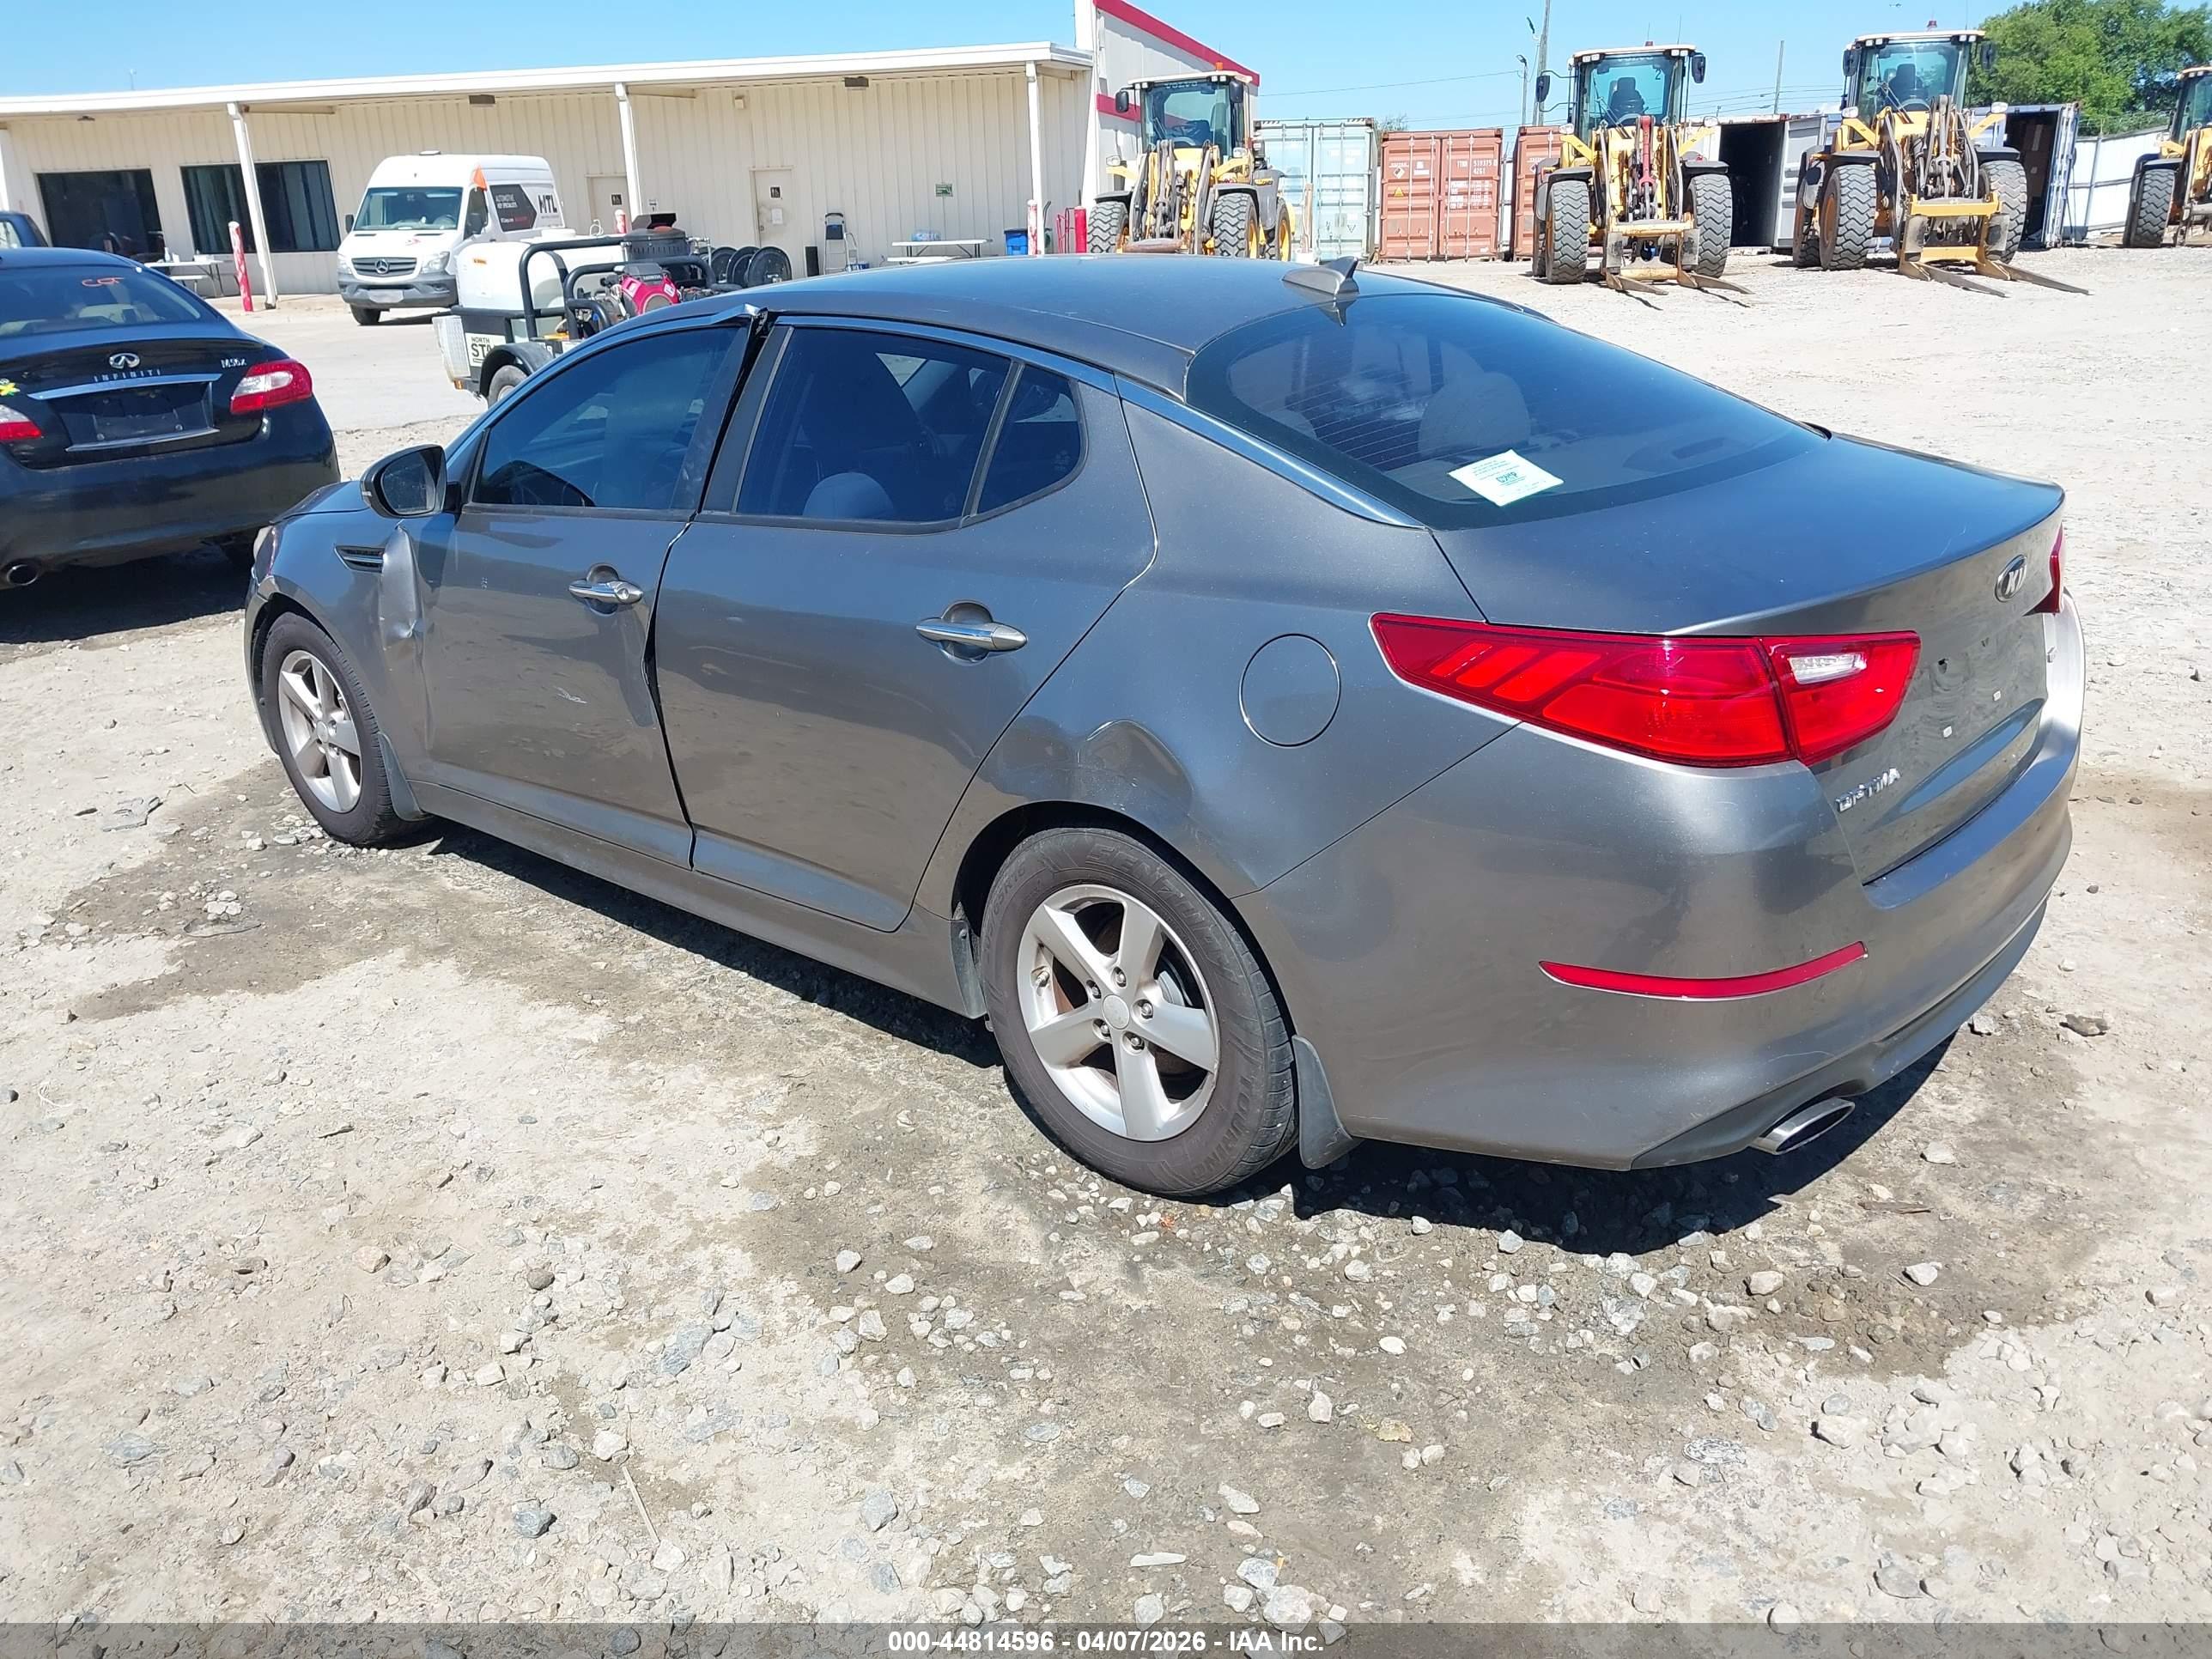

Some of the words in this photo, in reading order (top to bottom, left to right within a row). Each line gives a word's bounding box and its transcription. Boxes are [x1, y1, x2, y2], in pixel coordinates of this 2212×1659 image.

[94, 369, 161, 383] INFINITI
[1835, 767, 1901, 813] OPTIMA
[1192, 1075, 1253, 1180] TOURING
